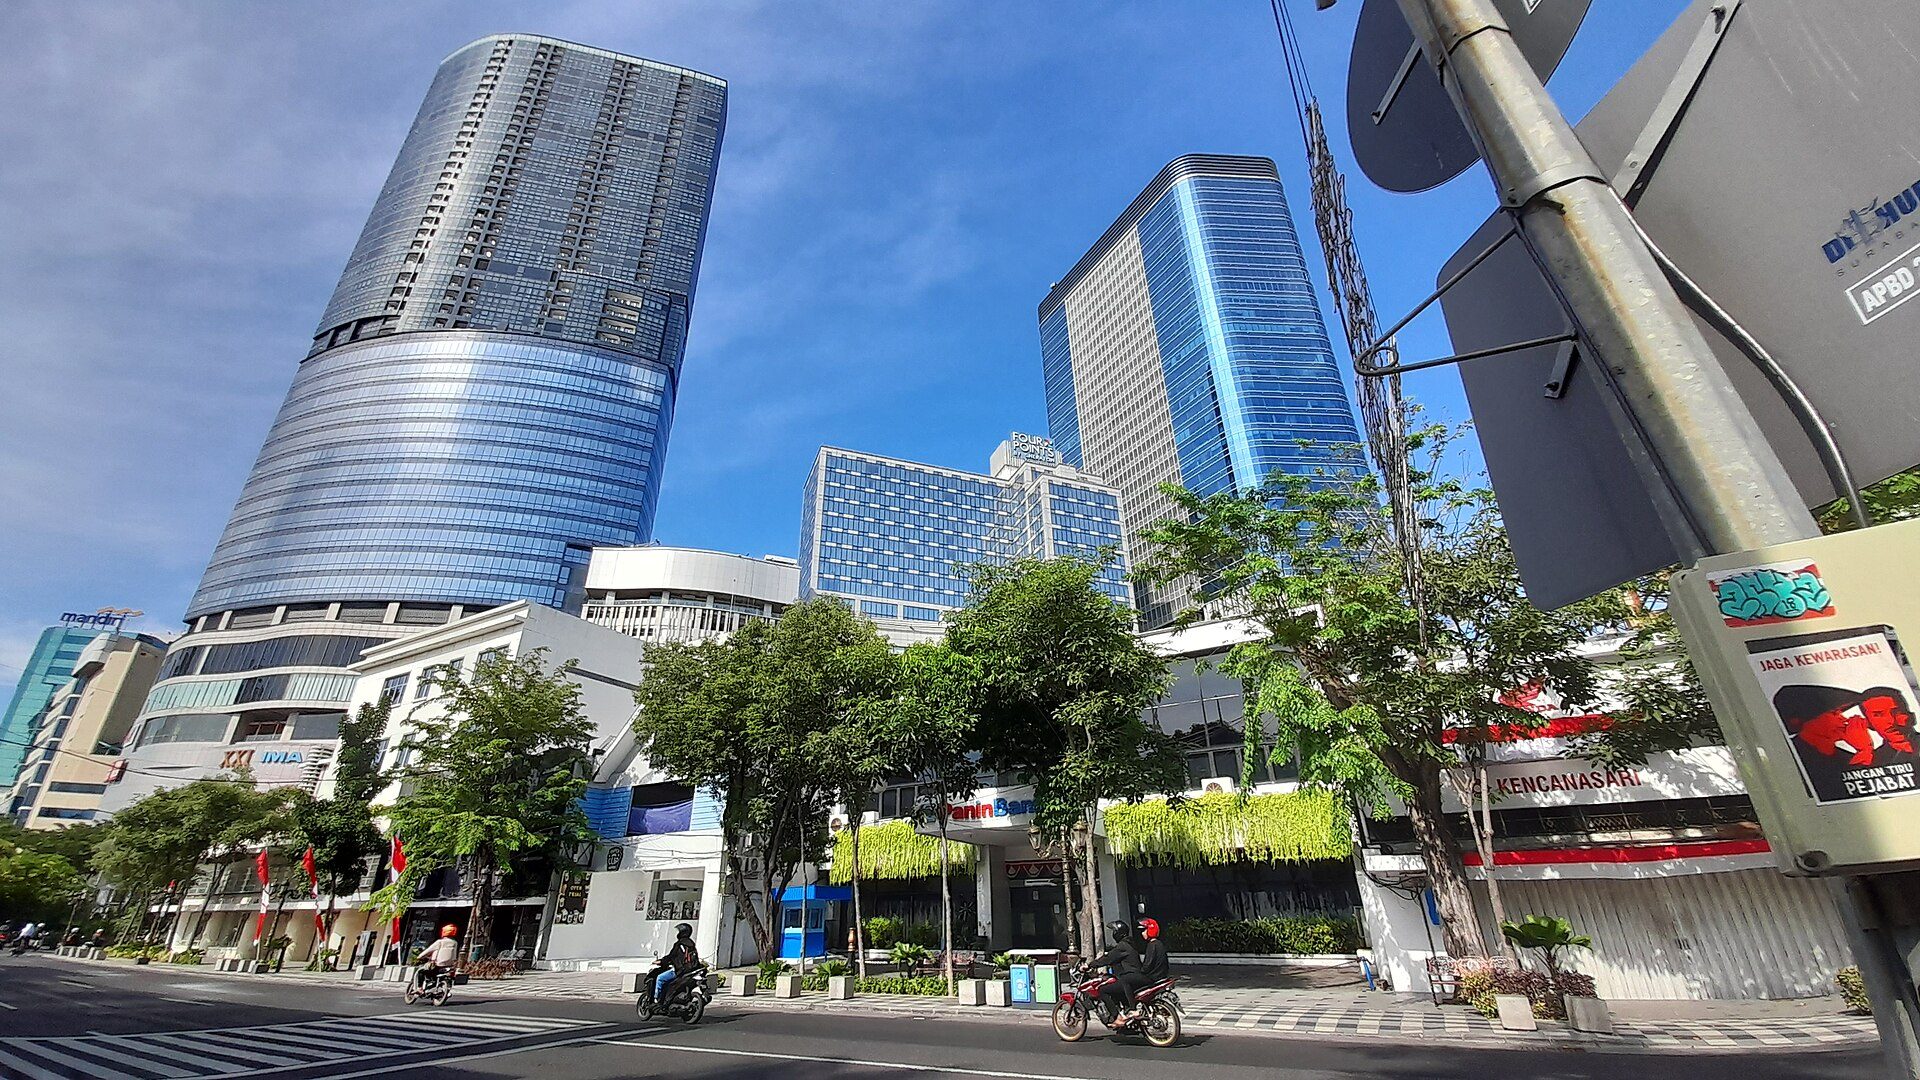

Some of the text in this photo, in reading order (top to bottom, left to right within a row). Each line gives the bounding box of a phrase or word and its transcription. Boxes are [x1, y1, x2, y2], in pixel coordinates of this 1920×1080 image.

[1861, 267, 1915, 313] APBD
[1012, 431, 1043, 447] FOUR
[1013, 440, 1055, 459] POINTS
[1760, 642, 1882, 672] JAGA KEWARASAN!
[220, 749, 256, 769] XXI
[1496, 768, 1642, 797] KENCANASARI
[1841, 763, 1914, 781] JANGAN TIRU
[1844, 773, 1916, 796] PEJABAT
